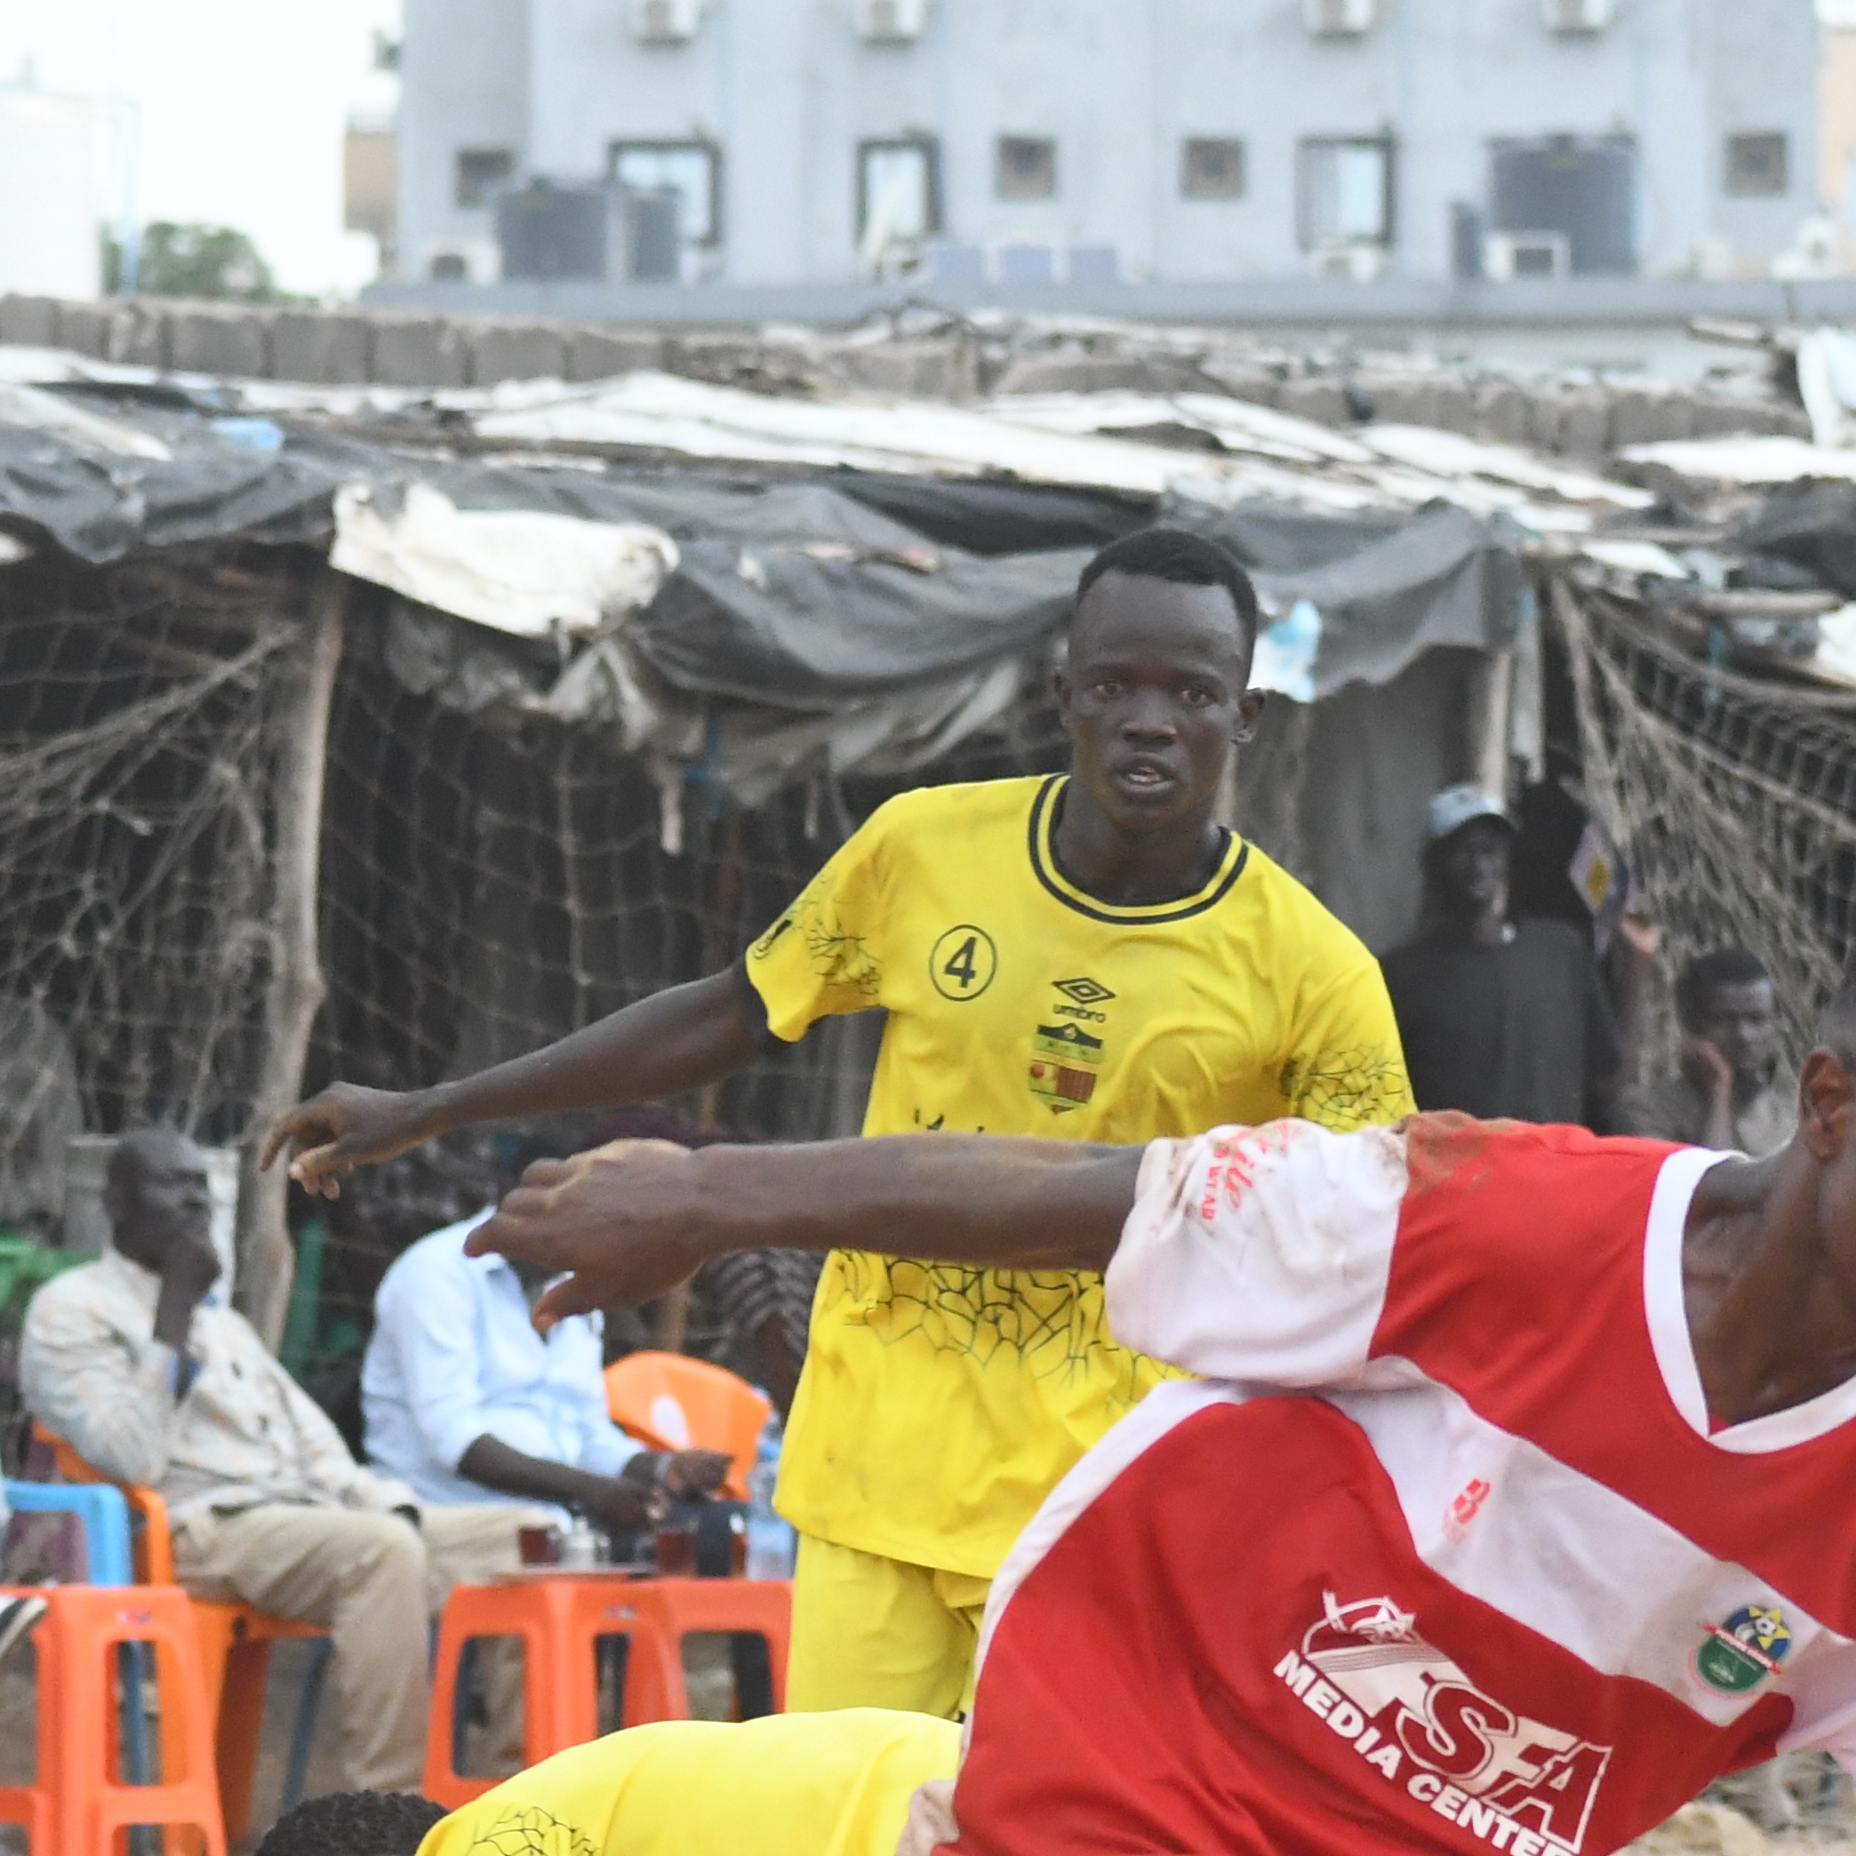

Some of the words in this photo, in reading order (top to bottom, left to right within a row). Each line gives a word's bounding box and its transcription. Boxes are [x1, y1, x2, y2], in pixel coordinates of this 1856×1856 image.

[943, 936, 976, 988] 4
[1052, 1003, 1107, 1024] umbro
[1273, 1648, 1404, 1780] MEDIA
